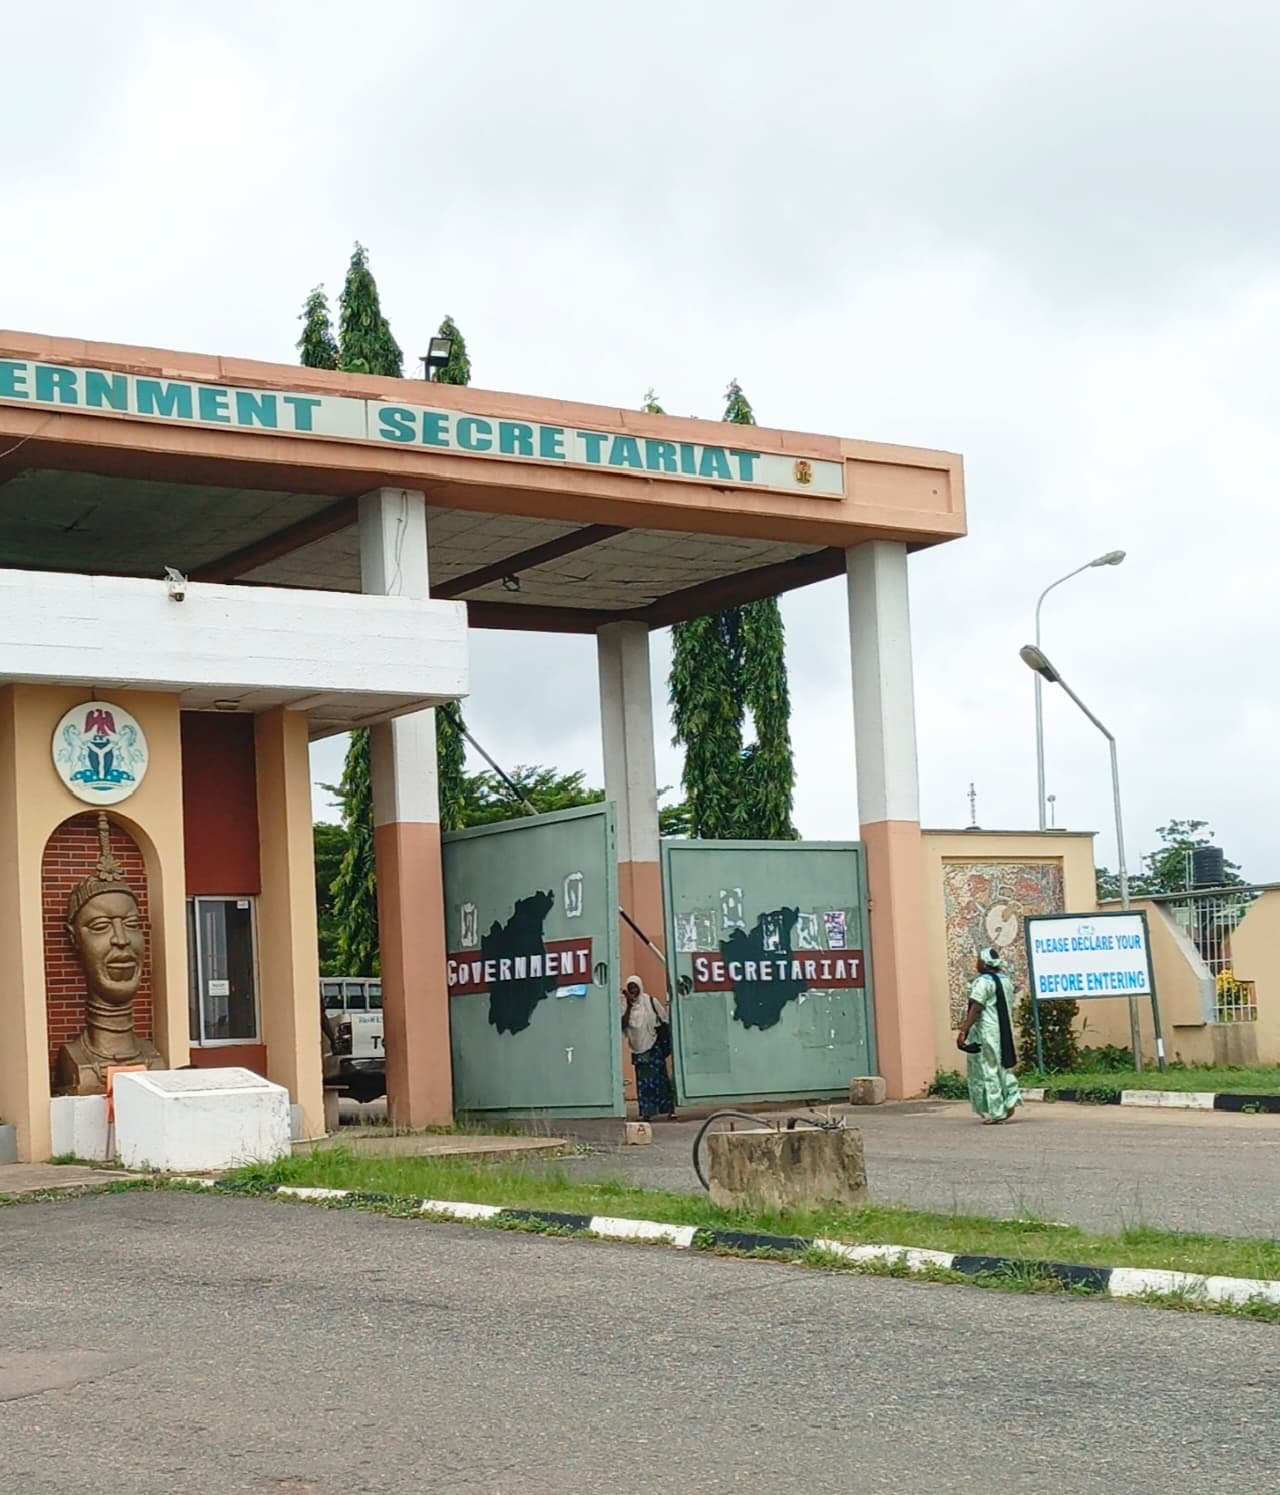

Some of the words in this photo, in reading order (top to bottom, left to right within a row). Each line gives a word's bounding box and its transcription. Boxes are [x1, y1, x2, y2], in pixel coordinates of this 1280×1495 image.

[378, 407, 760, 481] SECRETARIAT
[1035, 938, 1069, 953] PLEASE
[1071, 936, 1114, 951] DECLARE
[1115, 935, 1141, 949] YOUR
[447, 949, 589, 986] GOVERNMENT
[695, 957, 859, 982] SECRETARIAT
[1040, 973, 1084, 992] BEFORE
[1086, 971, 1145, 990] ENTERING
